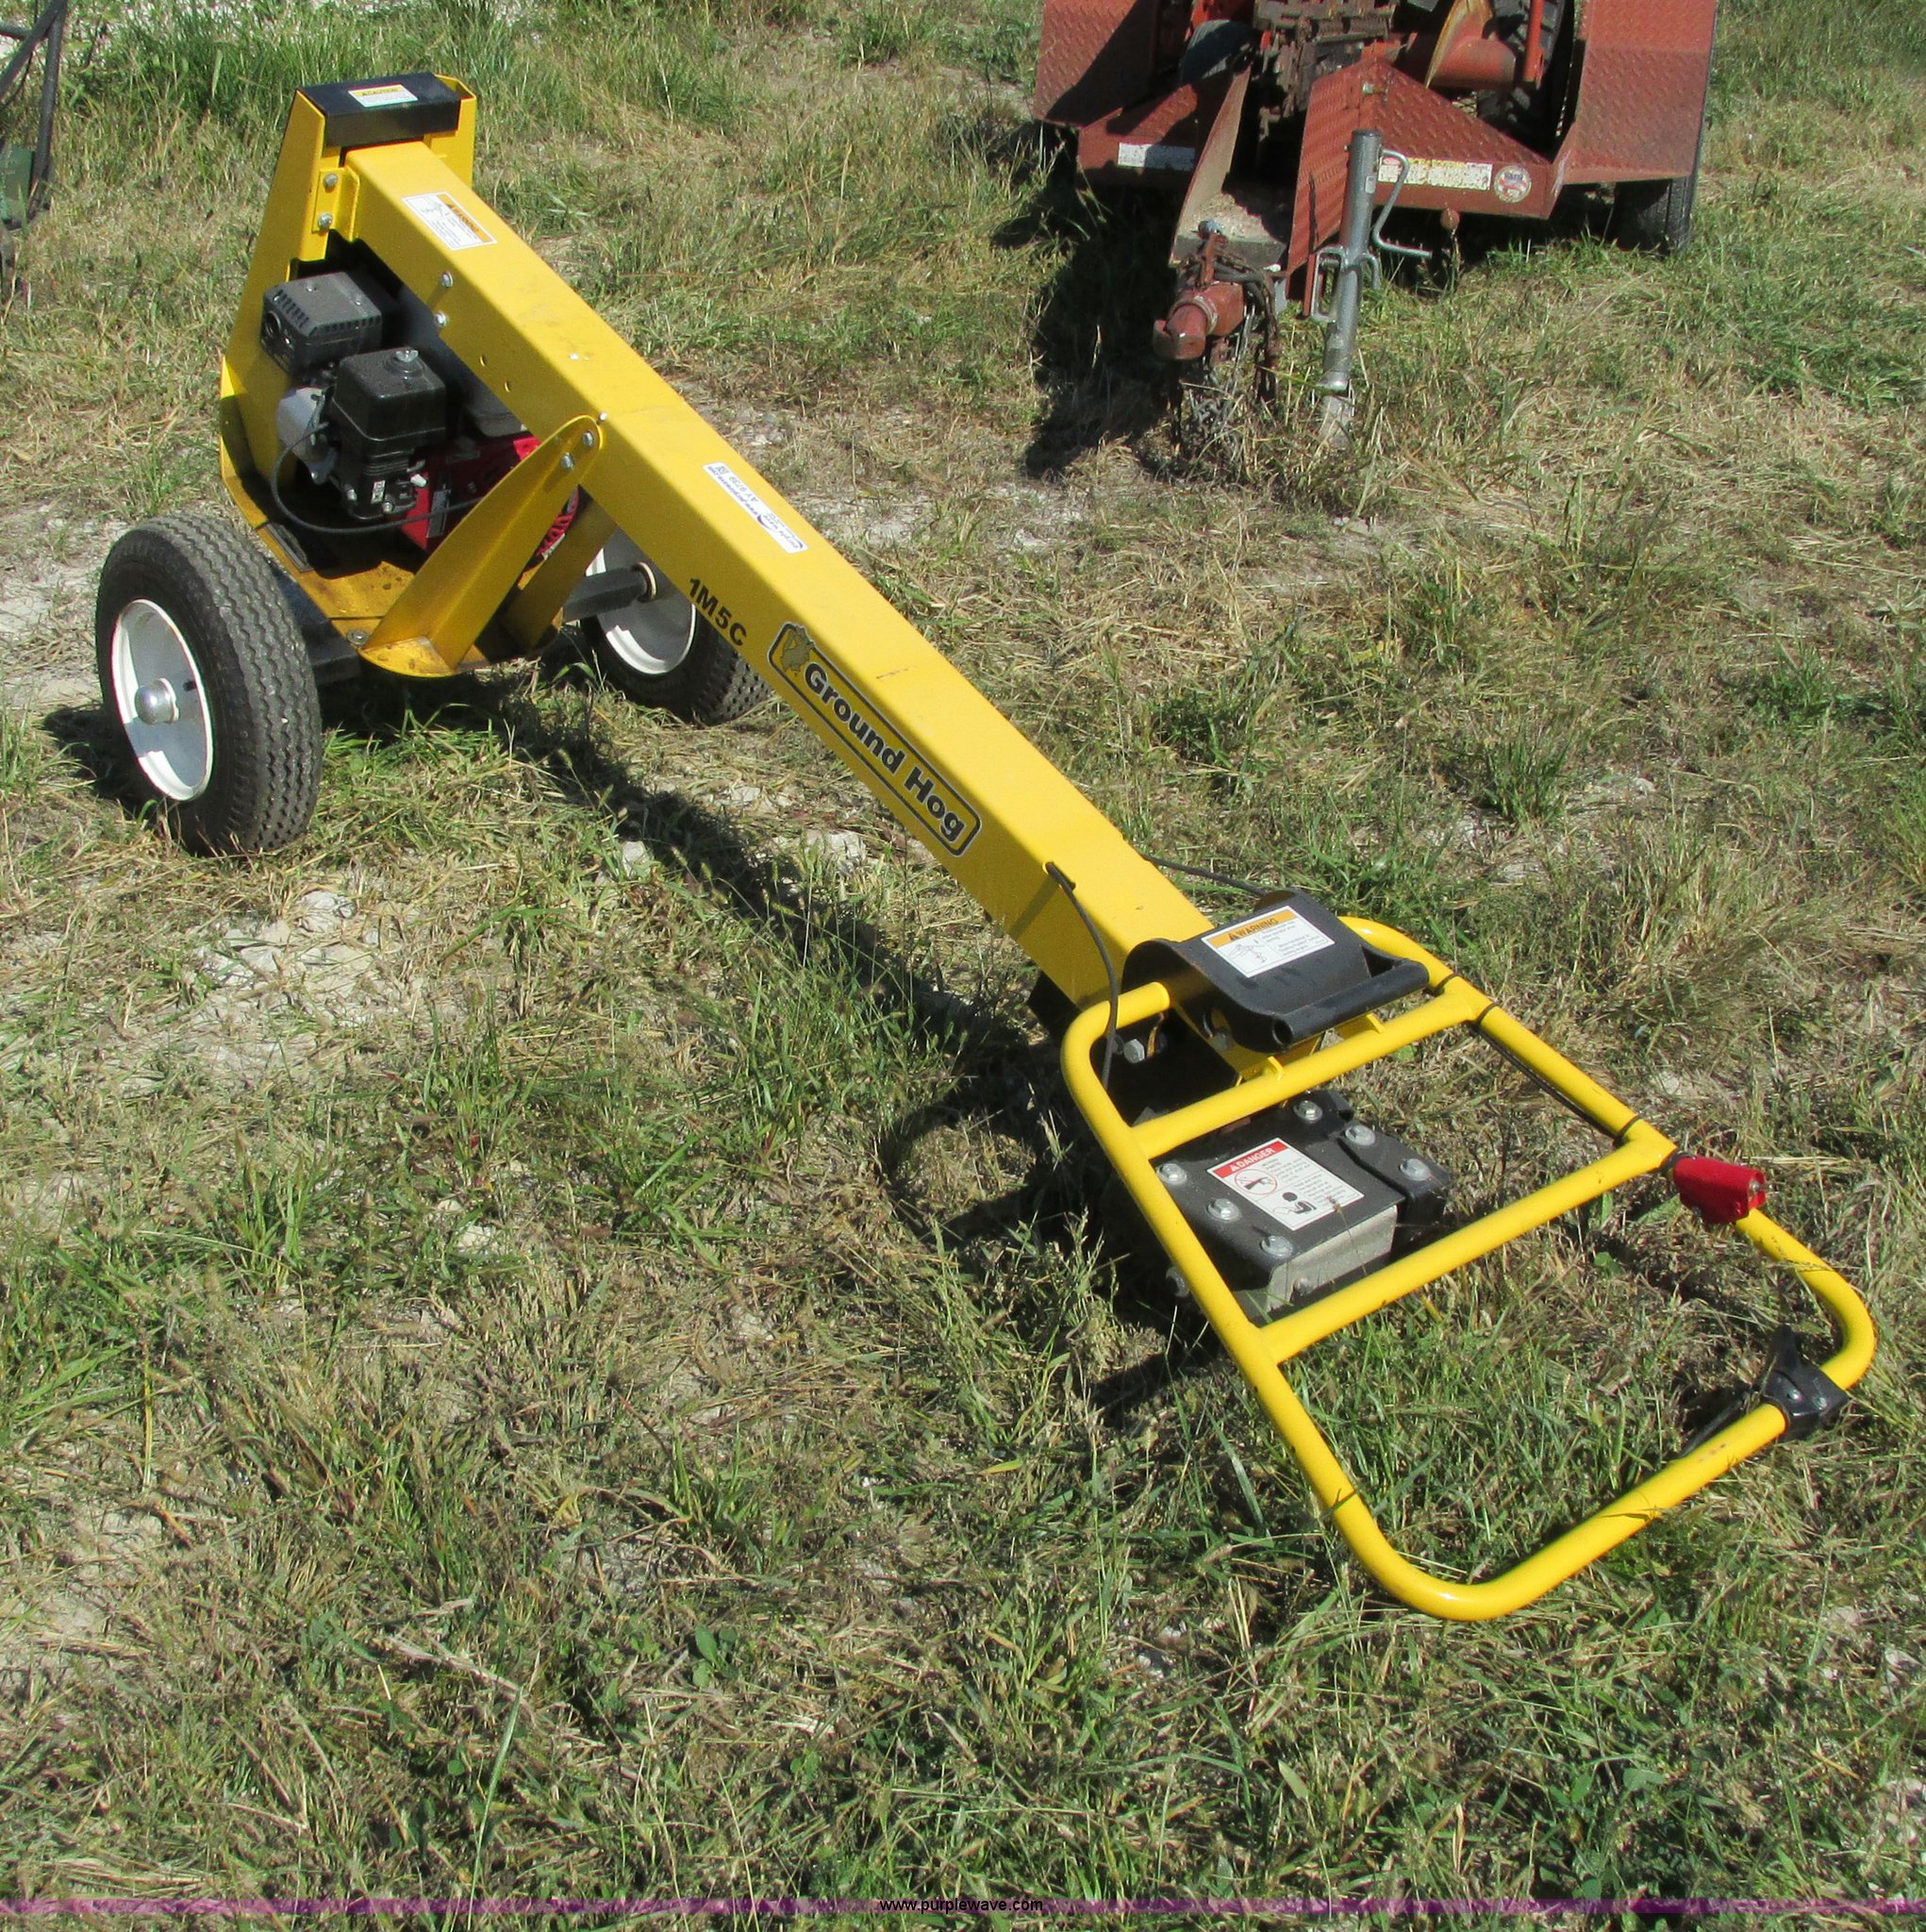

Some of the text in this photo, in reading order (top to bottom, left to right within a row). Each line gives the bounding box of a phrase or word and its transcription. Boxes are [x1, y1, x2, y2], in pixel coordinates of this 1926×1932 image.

[688, 577, 747, 646] 1M5C
[804, 662, 966, 842] Ground Hog
[1237, 918, 1279, 938] WARNING
[1237, 1147, 1276, 1167] DANGER
